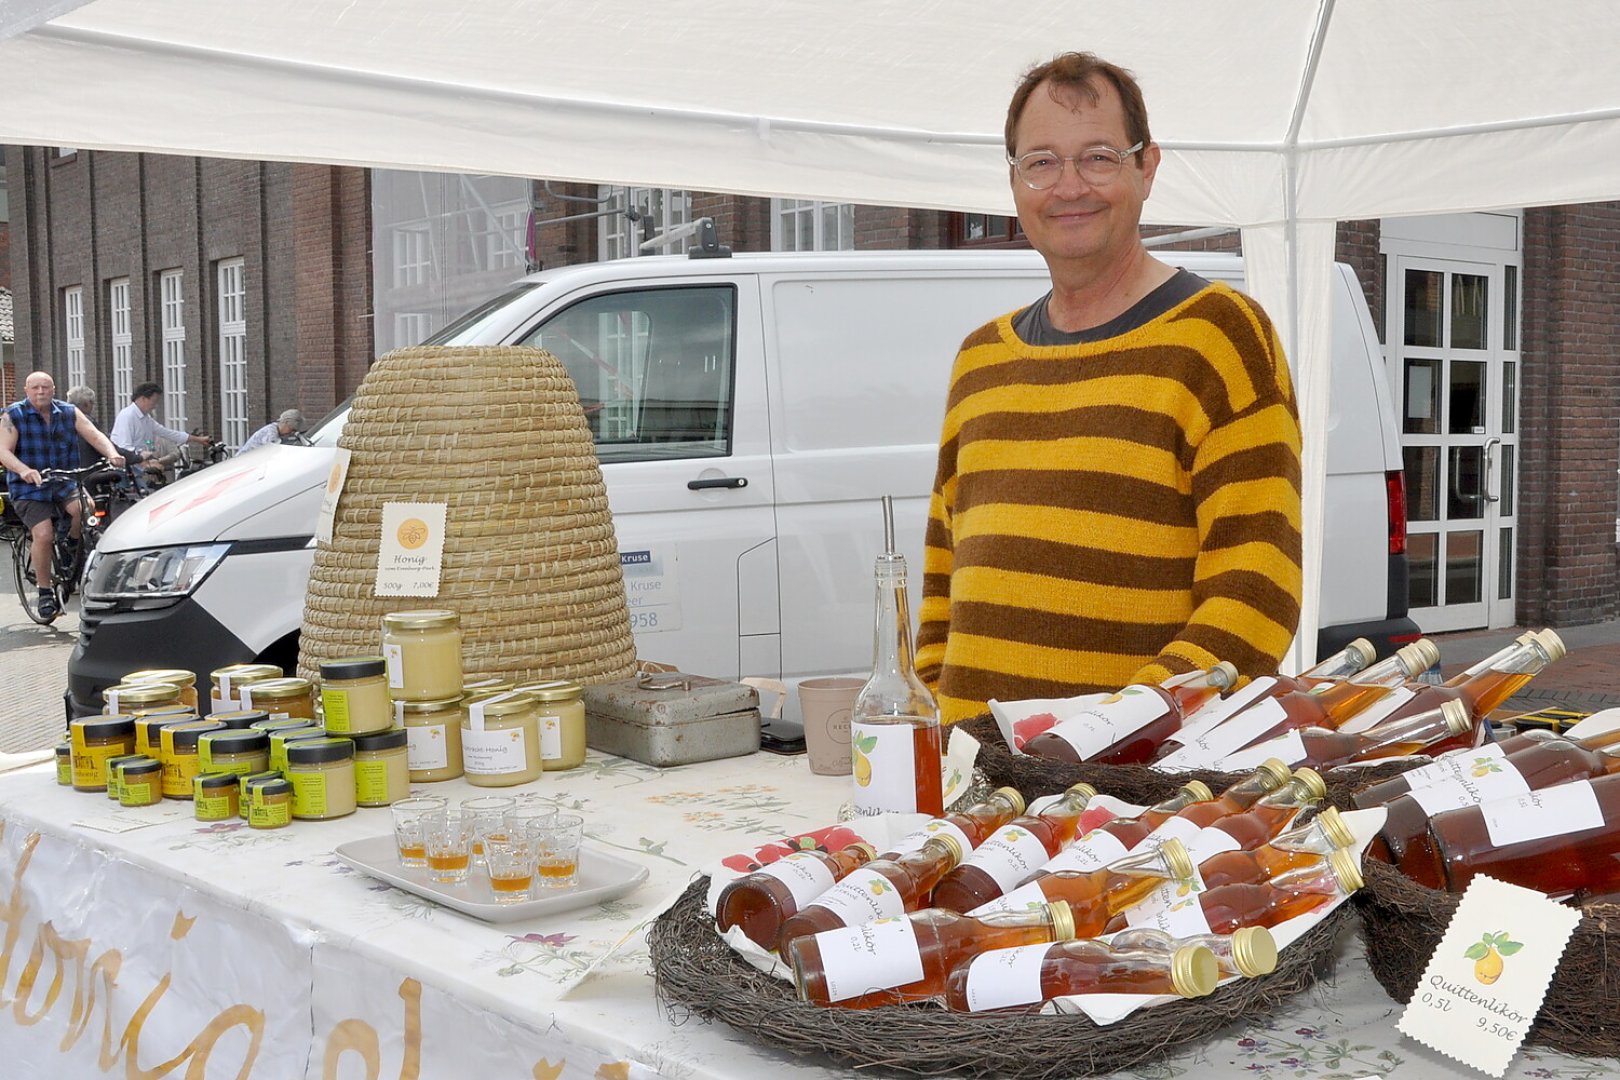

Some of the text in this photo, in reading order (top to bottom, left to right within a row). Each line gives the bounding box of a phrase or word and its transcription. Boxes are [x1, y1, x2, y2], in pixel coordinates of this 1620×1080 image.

[393, 554, 427, 566] Honig
[621, 553, 649, 564] Kruse
[383, 582, 402, 591] 500g
[630, 581, 662, 591] Kruse
[1430, 974, 1528, 1024] Quittenlikör
[1421, 992, 1519, 1042] 0,5l 9,50€
